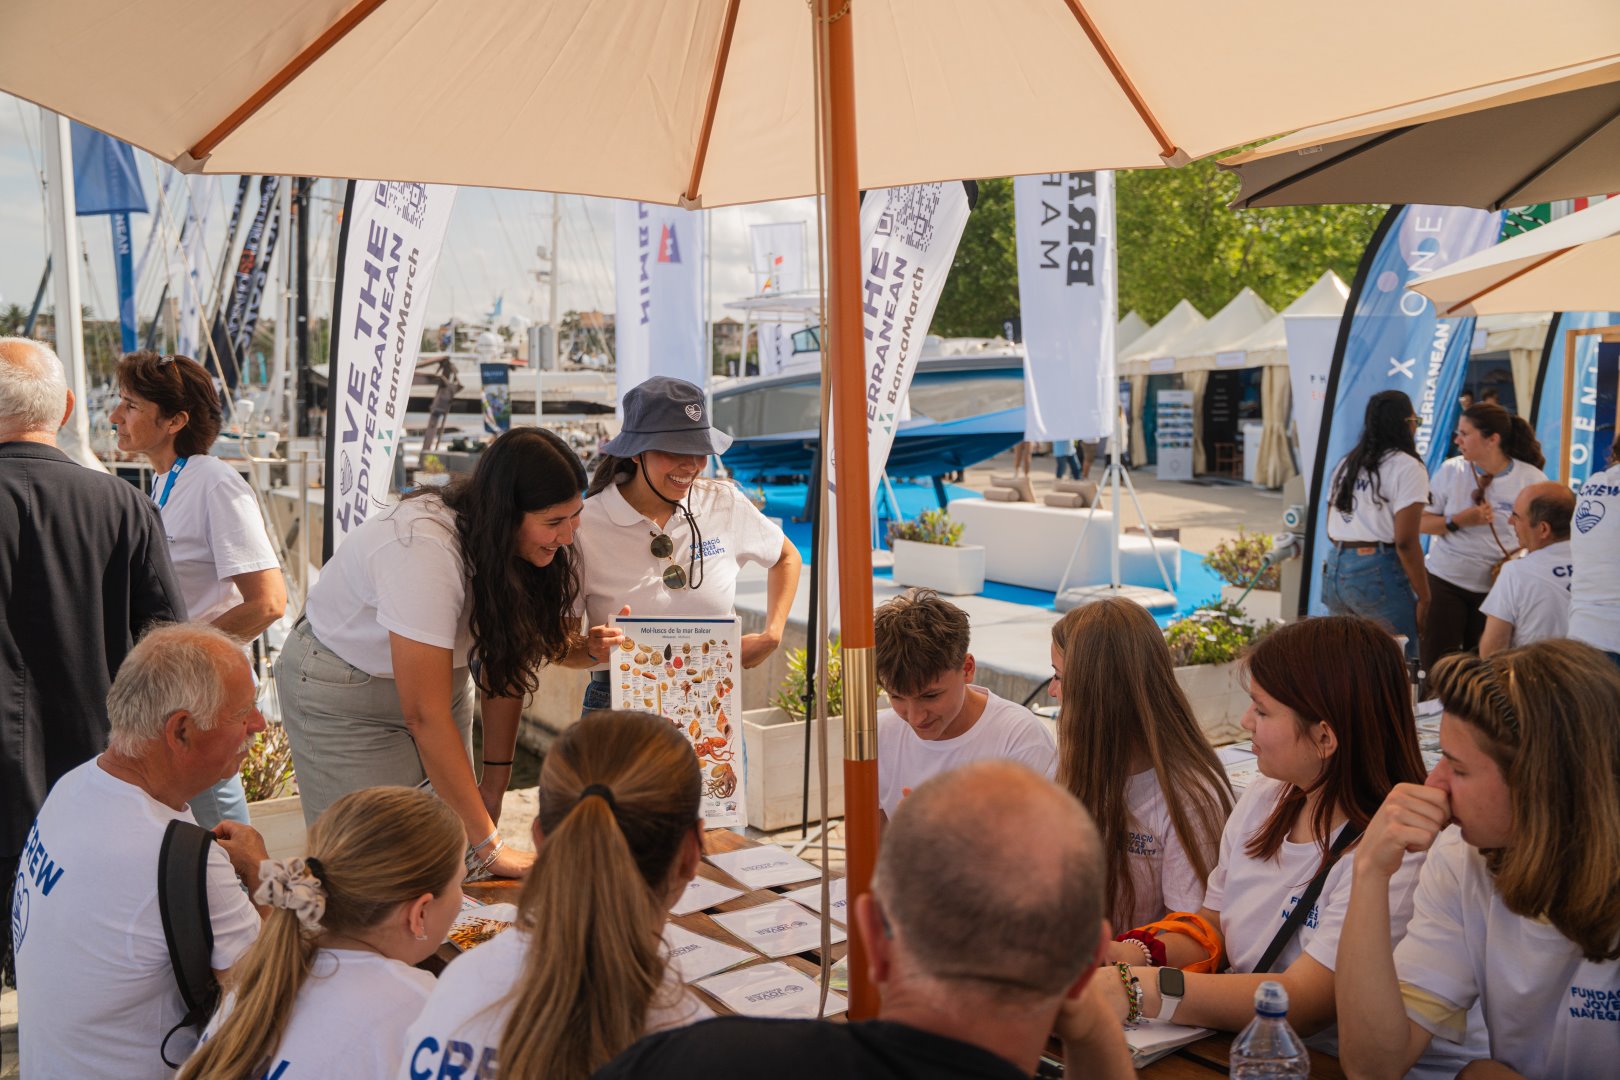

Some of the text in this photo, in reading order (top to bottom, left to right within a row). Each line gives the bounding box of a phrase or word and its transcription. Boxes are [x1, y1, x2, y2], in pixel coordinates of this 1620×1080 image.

[354, 219, 388, 340] THE
[385, 248, 419, 419] BancaMarch
[887, 267, 924, 404] BancaMarch
[1569, 1007, 1620, 1022] NAVEG
